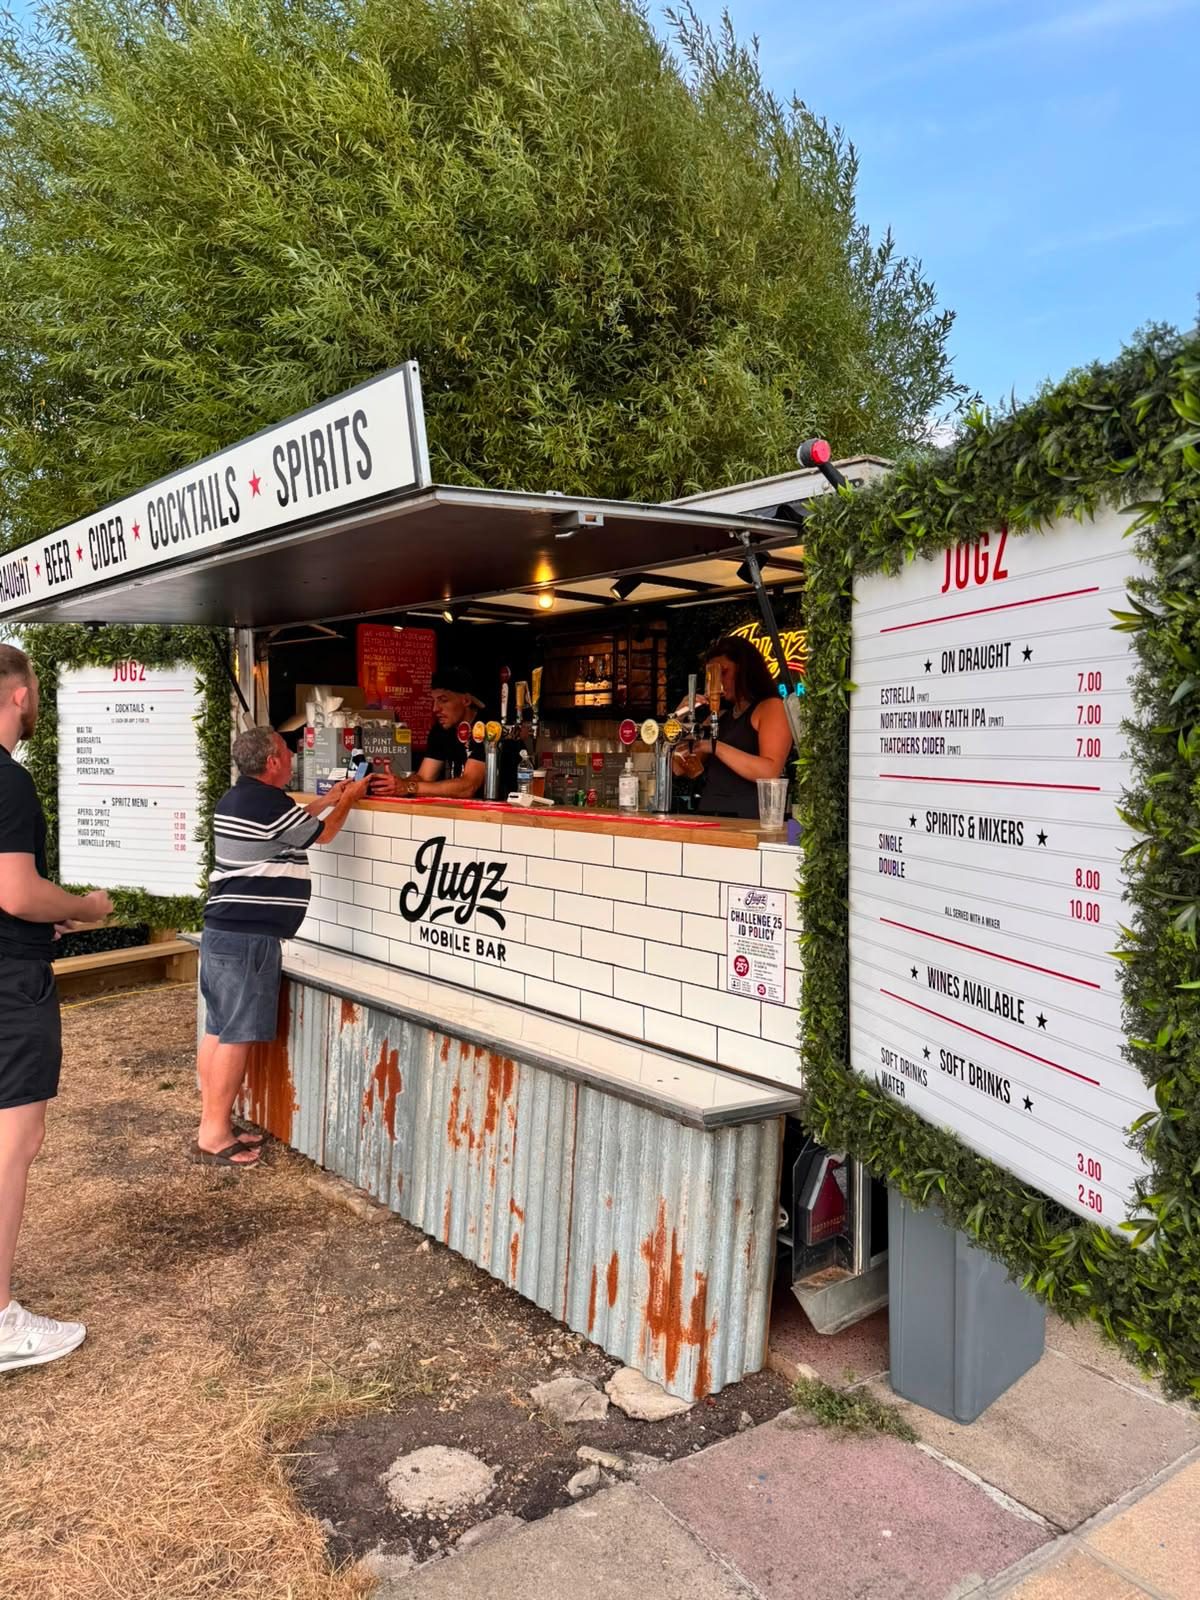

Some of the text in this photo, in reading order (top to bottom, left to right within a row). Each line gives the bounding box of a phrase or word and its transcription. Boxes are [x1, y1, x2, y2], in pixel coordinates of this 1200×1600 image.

[44, 539, 73, 586] BEER
[88, 516, 127, 571] CIDER
[147, 466, 240, 550] COCKTAILS
[273, 408, 373, 507] SPIRITS
[942, 527, 1008, 593] JUGZ
[941, 642, 1011, 674] ON DRAUGHT
[113, 660, 146, 682] JUGZ
[1077, 671, 1102, 692] 7.00
[880, 686, 915, 705] ESTRELLA
[115, 703, 145, 713] COCKTAILS
[880, 711, 917, 729] NORTHERN
[919, 710, 943, 728] MONK
[945, 708, 969, 728] FAITH
[971, 707, 986, 727] IPA
[1077, 704, 1101, 725] 7.00
[76, 736, 101, 744] MARGARITA
[364, 746, 407, 754] TUMBLERS
[880, 737, 920, 755] THATCHERS
[922, 737, 945, 755] CIDER
[1076, 738, 1101, 758] 7.00
[76, 757, 109, 765] GARDEN PUNCH
[77, 808, 110, 817] APEROL SPRITZ
[112, 797, 148, 808] SPRITZ MENU
[90, 829, 105, 837] SPRITZ
[94, 819, 110, 827] SPRITZ
[925, 810, 1024, 846] SPIRITS & MIXERS
[105, 840, 121, 848] SPRITZ
[879, 833, 903, 853] SINGLE
[879, 857, 905, 878] DOUBLE
[399, 836, 509, 924] Jugz
[1075, 868, 1101, 891] 8.00
[731, 910, 782, 930] CHALLENGE 25
[944, 906, 952, 917] ALL
[953, 908, 969, 921] SERVED
[970, 913, 981, 924] WITH
[985, 917, 1000, 929] MIXER
[1069, 899, 1101, 923] 10.00
[738, 924, 775, 941] ID POLICY
[420, 926, 506, 962] MOBILE BAR
[736, 963, 748, 974] 25?
[927, 966, 1025, 1025] WINES AVAILABLE
[881, 1047, 928, 1087] SOFT DRINKS
[939, 1049, 1011, 1105] SOFT DRINKS
[881, 1070, 905, 1099] WATER
[1077, 1152, 1102, 1181] 3.00
[1078, 1184, 1103, 1213] 2.50
